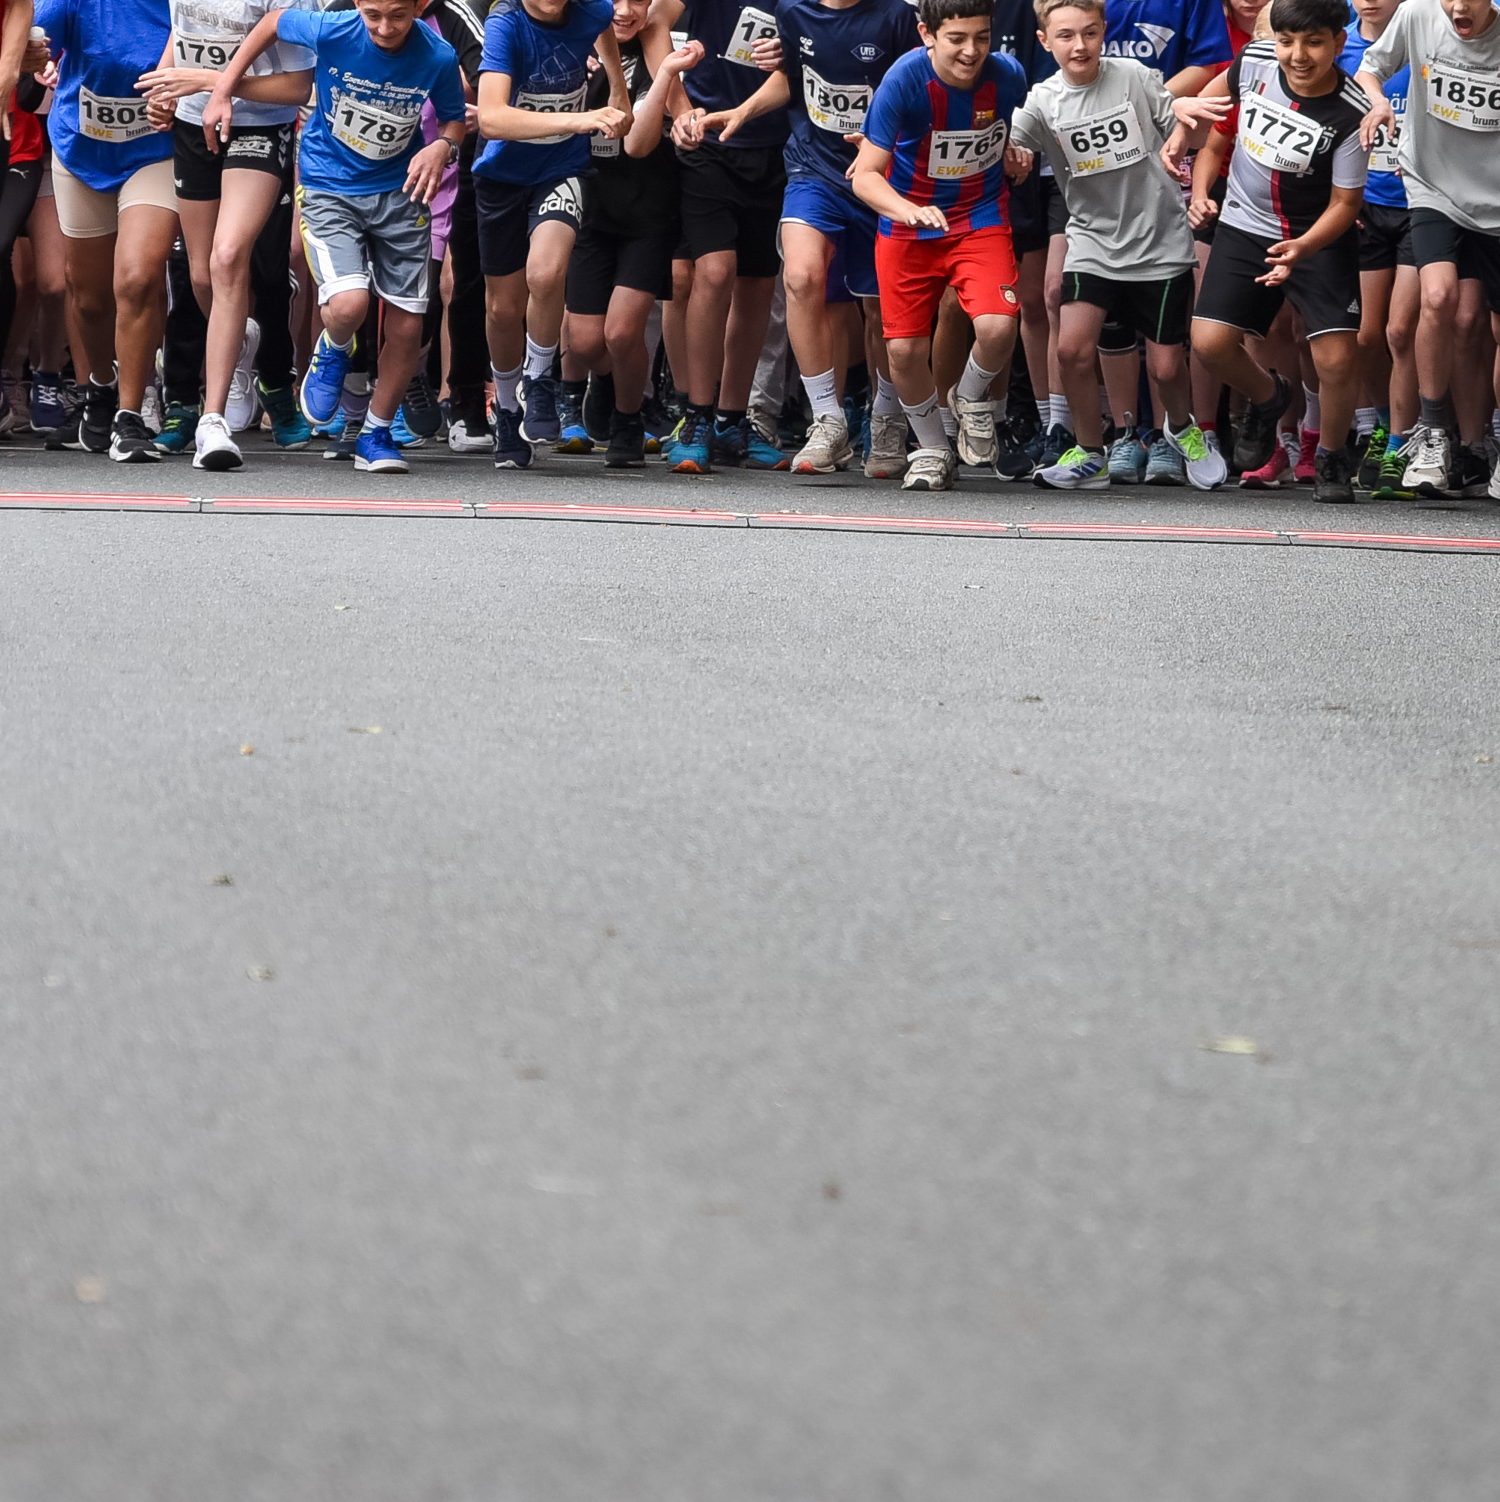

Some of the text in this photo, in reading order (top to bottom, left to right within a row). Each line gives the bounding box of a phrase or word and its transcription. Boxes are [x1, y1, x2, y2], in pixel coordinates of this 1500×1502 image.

[740, 21, 779, 43] 18
[734, 48, 754, 62] EW
[806, 78, 868, 114] 1804
[341, 109, 415, 143] 1782
[839, 119, 862, 129] brun
[1433, 103, 1500, 126] EWE bruns
[85, 125, 113, 138] EWE
[340, 131, 368, 151] EWE
[934, 126, 1004, 159] 1765
[1071, 119, 1128, 153] 659
[1245, 107, 1314, 156] 1772
[592, 144, 613, 152] runs
[1076, 146, 1141, 172] EWE bruns
[1243, 136, 1301, 170] EWE bruns
[936, 165, 968, 175] EWE
[538, 197, 582, 229] adida
